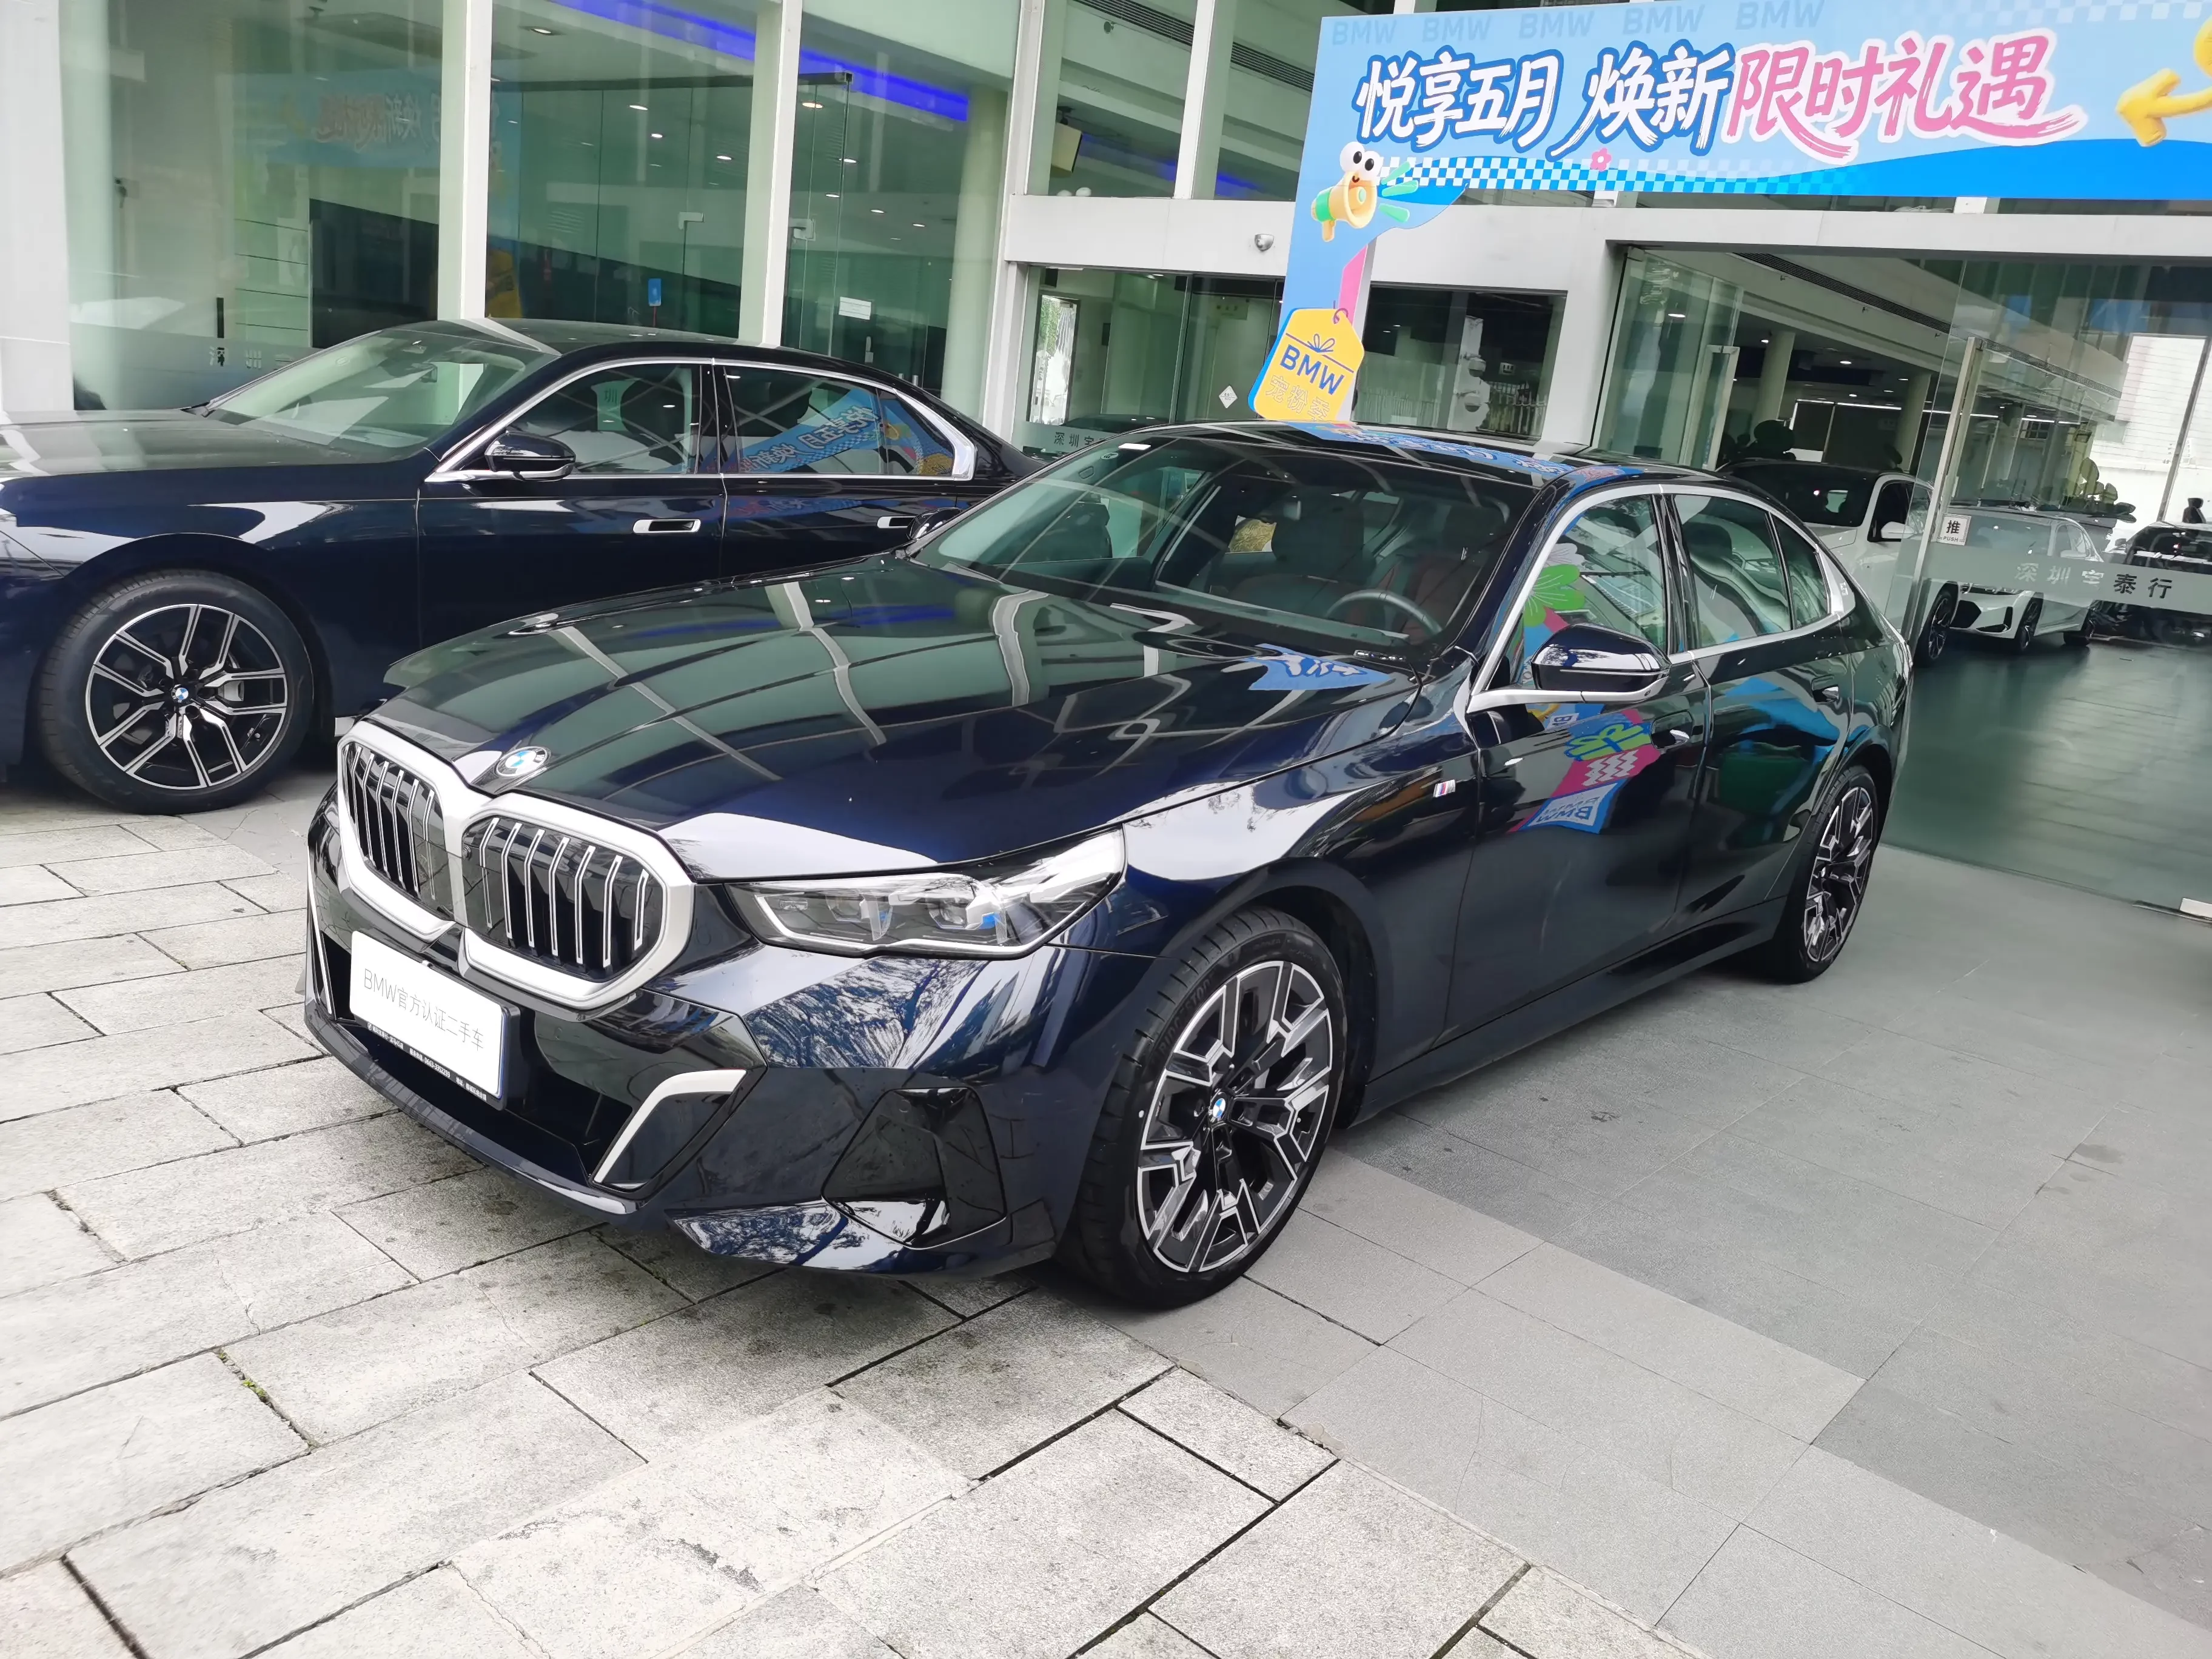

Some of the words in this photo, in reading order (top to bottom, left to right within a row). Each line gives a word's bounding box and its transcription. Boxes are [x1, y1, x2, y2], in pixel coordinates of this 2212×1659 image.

[1332, 19, 1395, 45] BMW
[1422, 16, 1491, 42] BMW
[1519, 12, 1595, 40] BMW
[1623, 7, 1704, 35] BMW
[1735, 1, 1820, 30] BMW
[1355, 52, 1559, 149] 悦享五月
[1550, 35, 2083, 159] 焕新限时礼遇
[1280, 344, 1344, 395] BMW
[1265, 375, 1330, 422] 宠粉季
[1054, 431, 1106, 448] 深圳宝
[1946, 520, 1960, 534] 推
[2014, 563, 2173, 599] 深圳宝泰行
[364, 968, 484, 1051] BMW官方认证二手车
